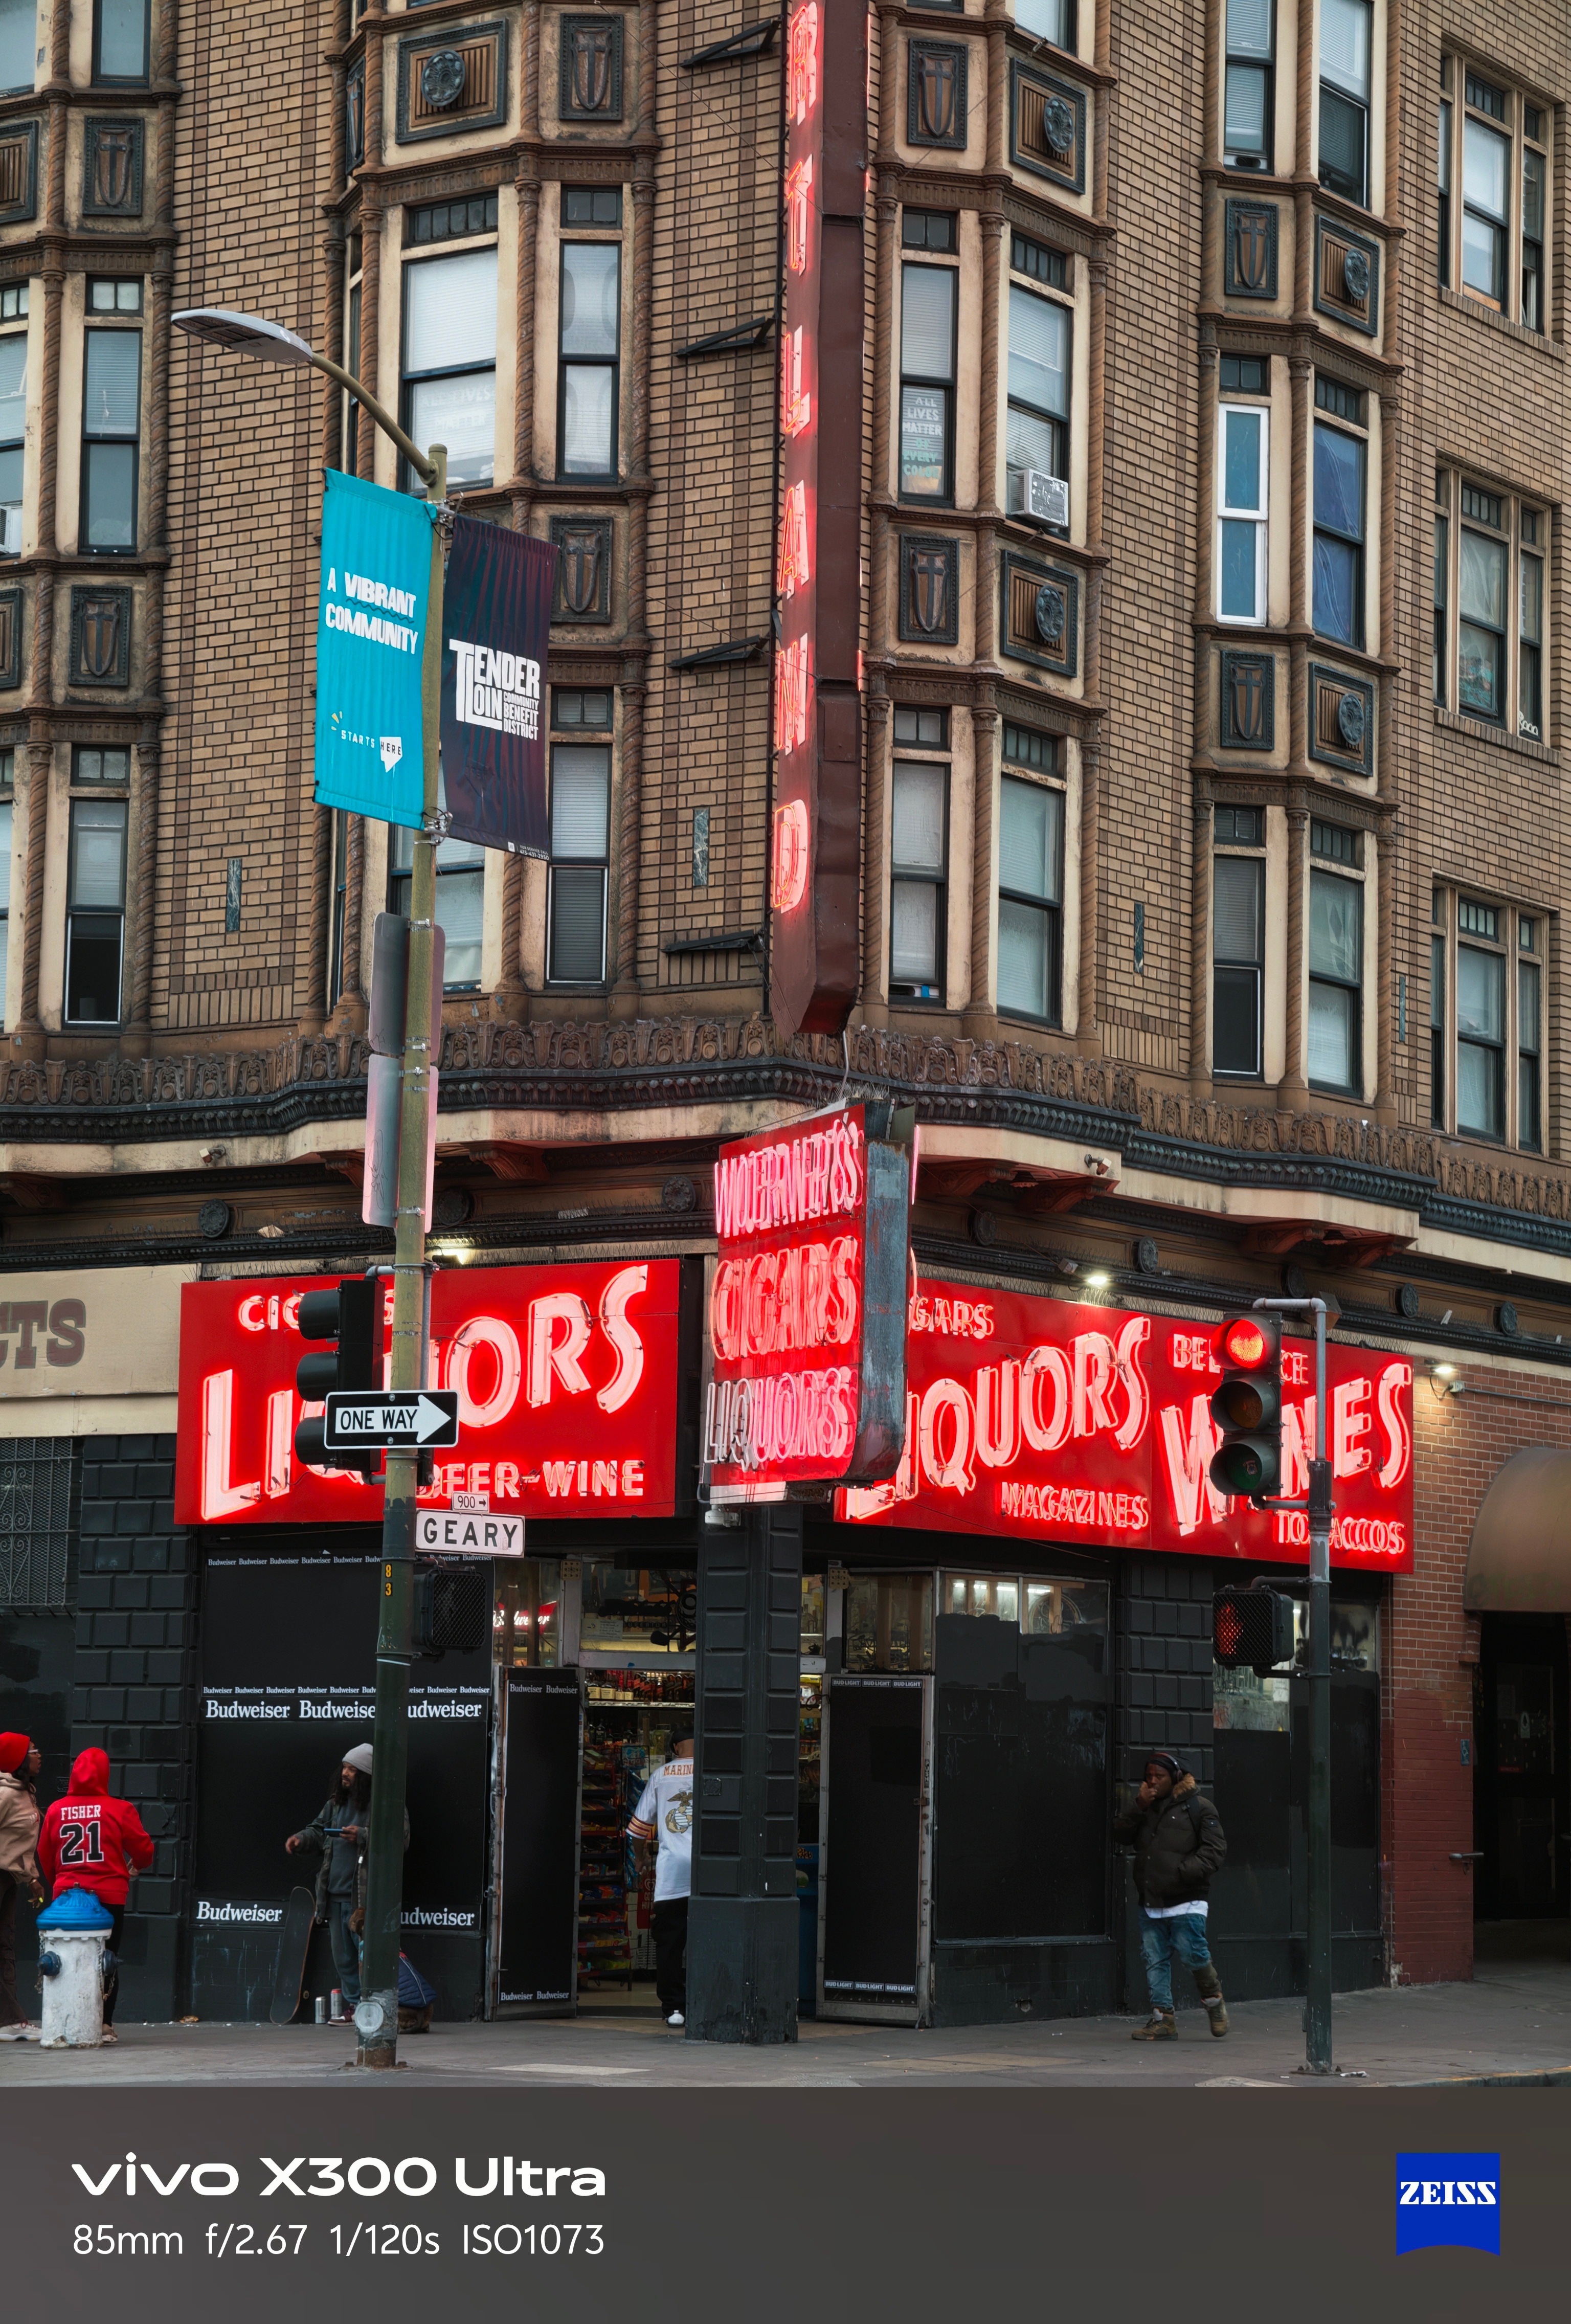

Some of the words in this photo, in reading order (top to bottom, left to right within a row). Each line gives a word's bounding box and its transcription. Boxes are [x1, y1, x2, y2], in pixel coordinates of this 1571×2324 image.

[915, 397, 937, 407] ALL
[908, 408, 939, 421] LIVES
[902, 421, 942, 436] MATTER
[903, 450, 938, 462] EVERY
[903, 464, 940, 479] COLOR
[327, 567, 336, 592] A
[344, 572, 416, 618] VIBRANT
[325, 602, 418, 654] COMMUNITY
[449, 639, 541, 723] TENDER
[503, 690, 540, 709] COMMUNITY
[503, 705, 539, 727] BENEFIT
[503, 720, 539, 741] DISTRICT
[341, 729, 375, 749] STARTS
[380, 740, 403, 756] HERE
[520, 849, 549, 861] 415-431-2950
[710, 1235, 861, 1361] CIGARS
[909, 1294, 994, 1339] GARS
[0, 1298, 86, 1369] TS
[200, 1264, 648, 1521] LIORS
[340, 1410, 374, 1431] ONE
[381, 1409, 418, 1429] WAY
[704, 1366, 857, 1472] LIQUORS
[1159, 1363, 1411, 1536] WNES
[457, 1495, 476, 1509] 900
[1002, 1481, 1149, 1530] MAGAZINES
[423, 1517, 518, 1548] GEARY
[1275, 1510, 1405, 1554] TOACCOS
[510, 1684, 543, 1693] Budweiser
[546, 1684, 578, 1694] Budweiser
[206, 1700, 290, 1718] Budweiser
[299, 1700, 376, 1718] Budweise
[408, 1700, 482, 1718] udweiser
[664, 1764, 694, 1776] MARIN
[61, 1805, 101, 1821] FISHER
[59, 1821, 104, 1865] 21
[196, 1901, 283, 1922] Budweiser
[400, 1906, 475, 1926] udweiser
[501, 1992, 533, 2001] Budweiser
[536, 1991, 569, 2000] Budweiser
